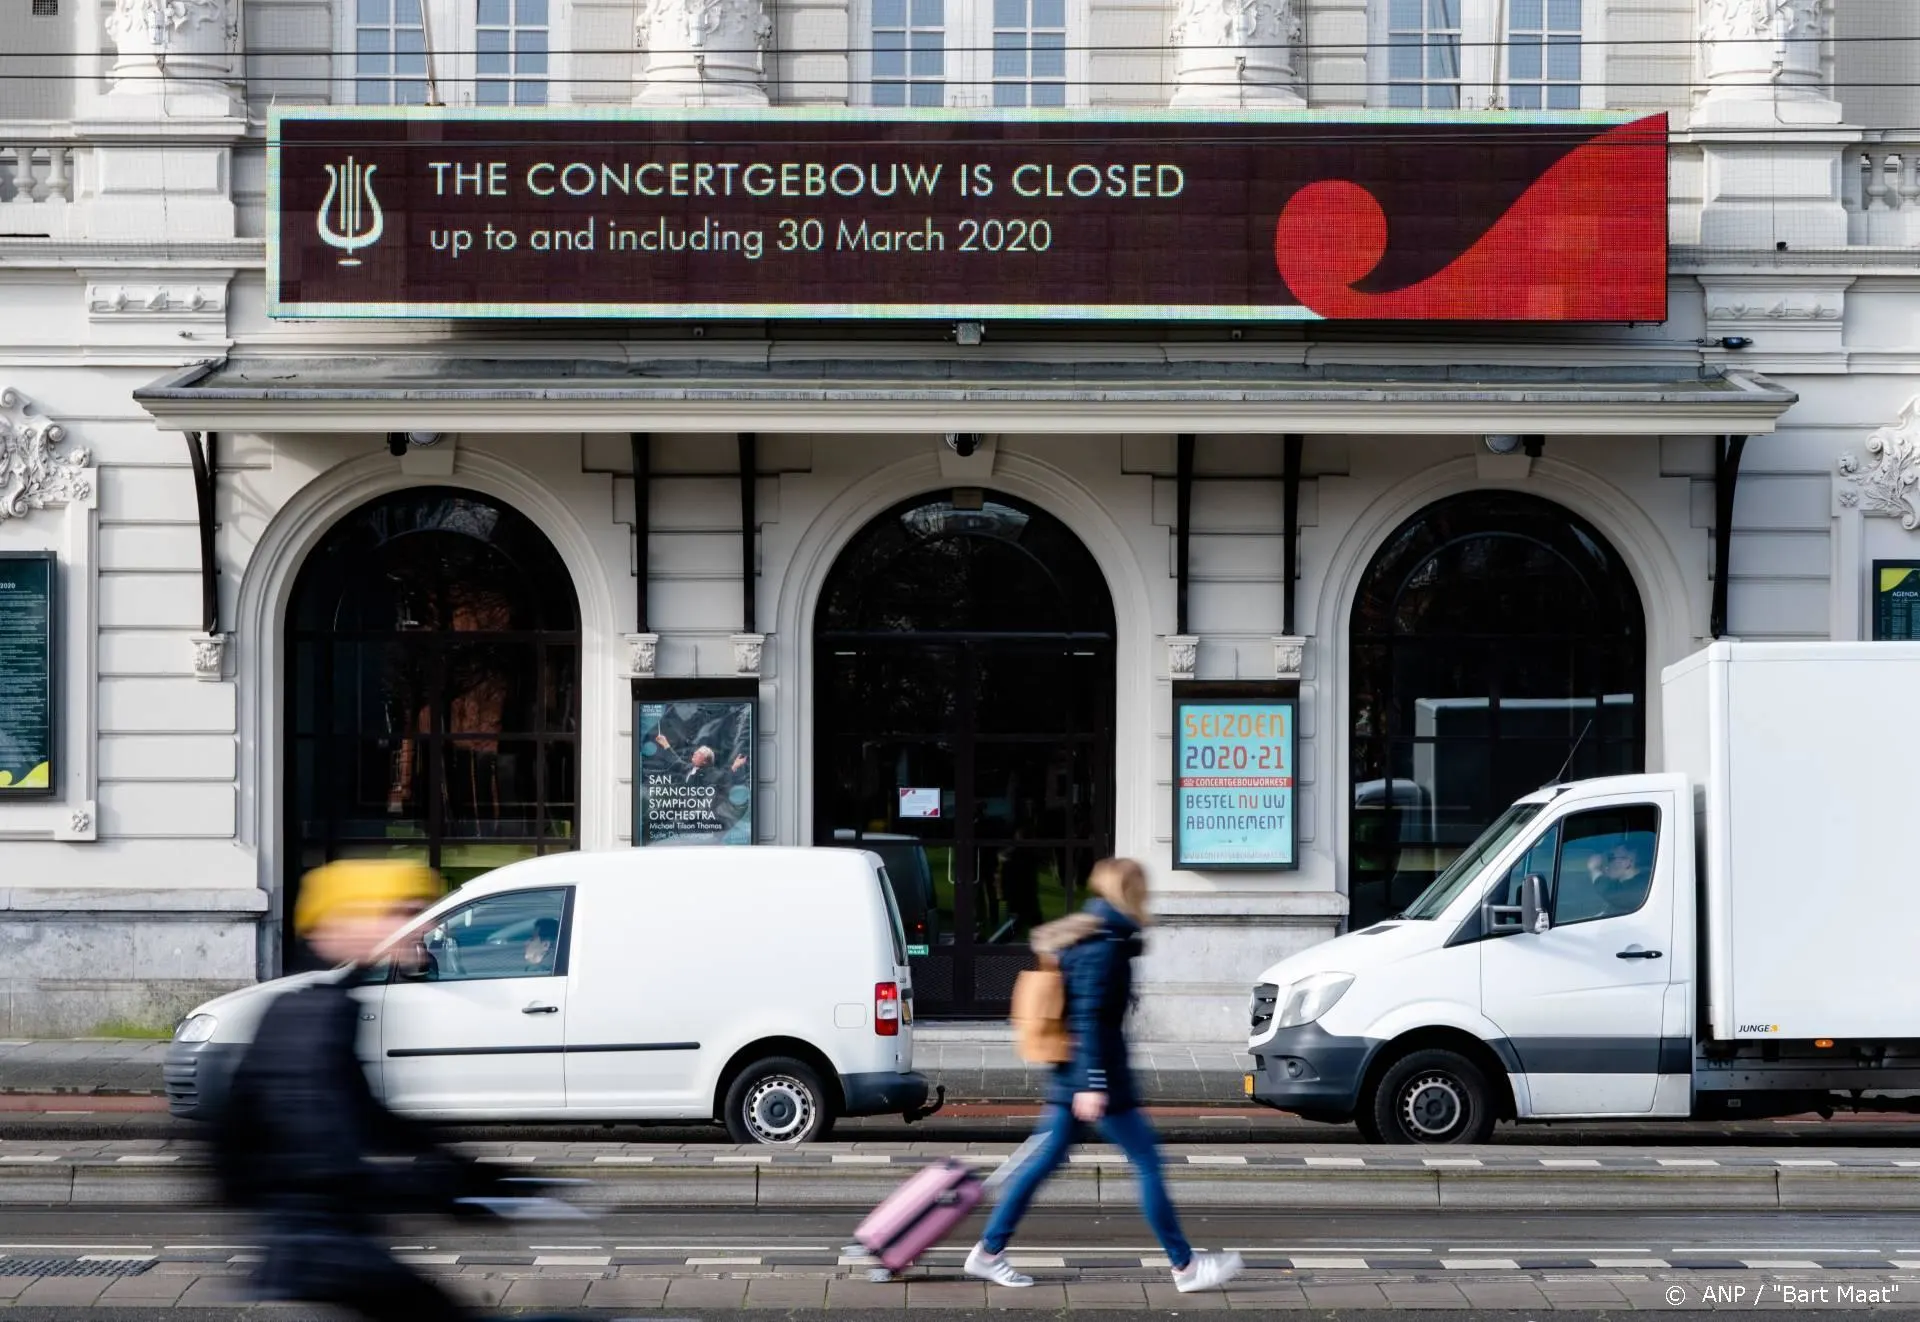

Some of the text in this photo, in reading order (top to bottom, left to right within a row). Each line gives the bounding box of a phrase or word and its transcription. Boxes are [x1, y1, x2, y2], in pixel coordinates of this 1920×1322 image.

[428, 161, 1185, 198] THE CONCERTGEBOUW IS CLOSED
[430, 216, 1053, 259] up to and including 30 March 2020
[648, 774, 672, 785] SAN
[1195, 778, 1288, 787] CONCERTGEBOUWORKEST
[648, 786, 716, 797] FRANCISCO
[648, 798, 713, 809] SYMPHONY
[1186, 794, 1235, 809] BESTEL
[1263, 794, 1285, 809] UW
[648, 810, 716, 821] ORCHESTRA
[649, 822, 723, 830] Michael Tilson Thomas
[1186, 815, 1285, 830] ABONNEMENT
[1738, 1024, 1771, 1033] JUNGE
